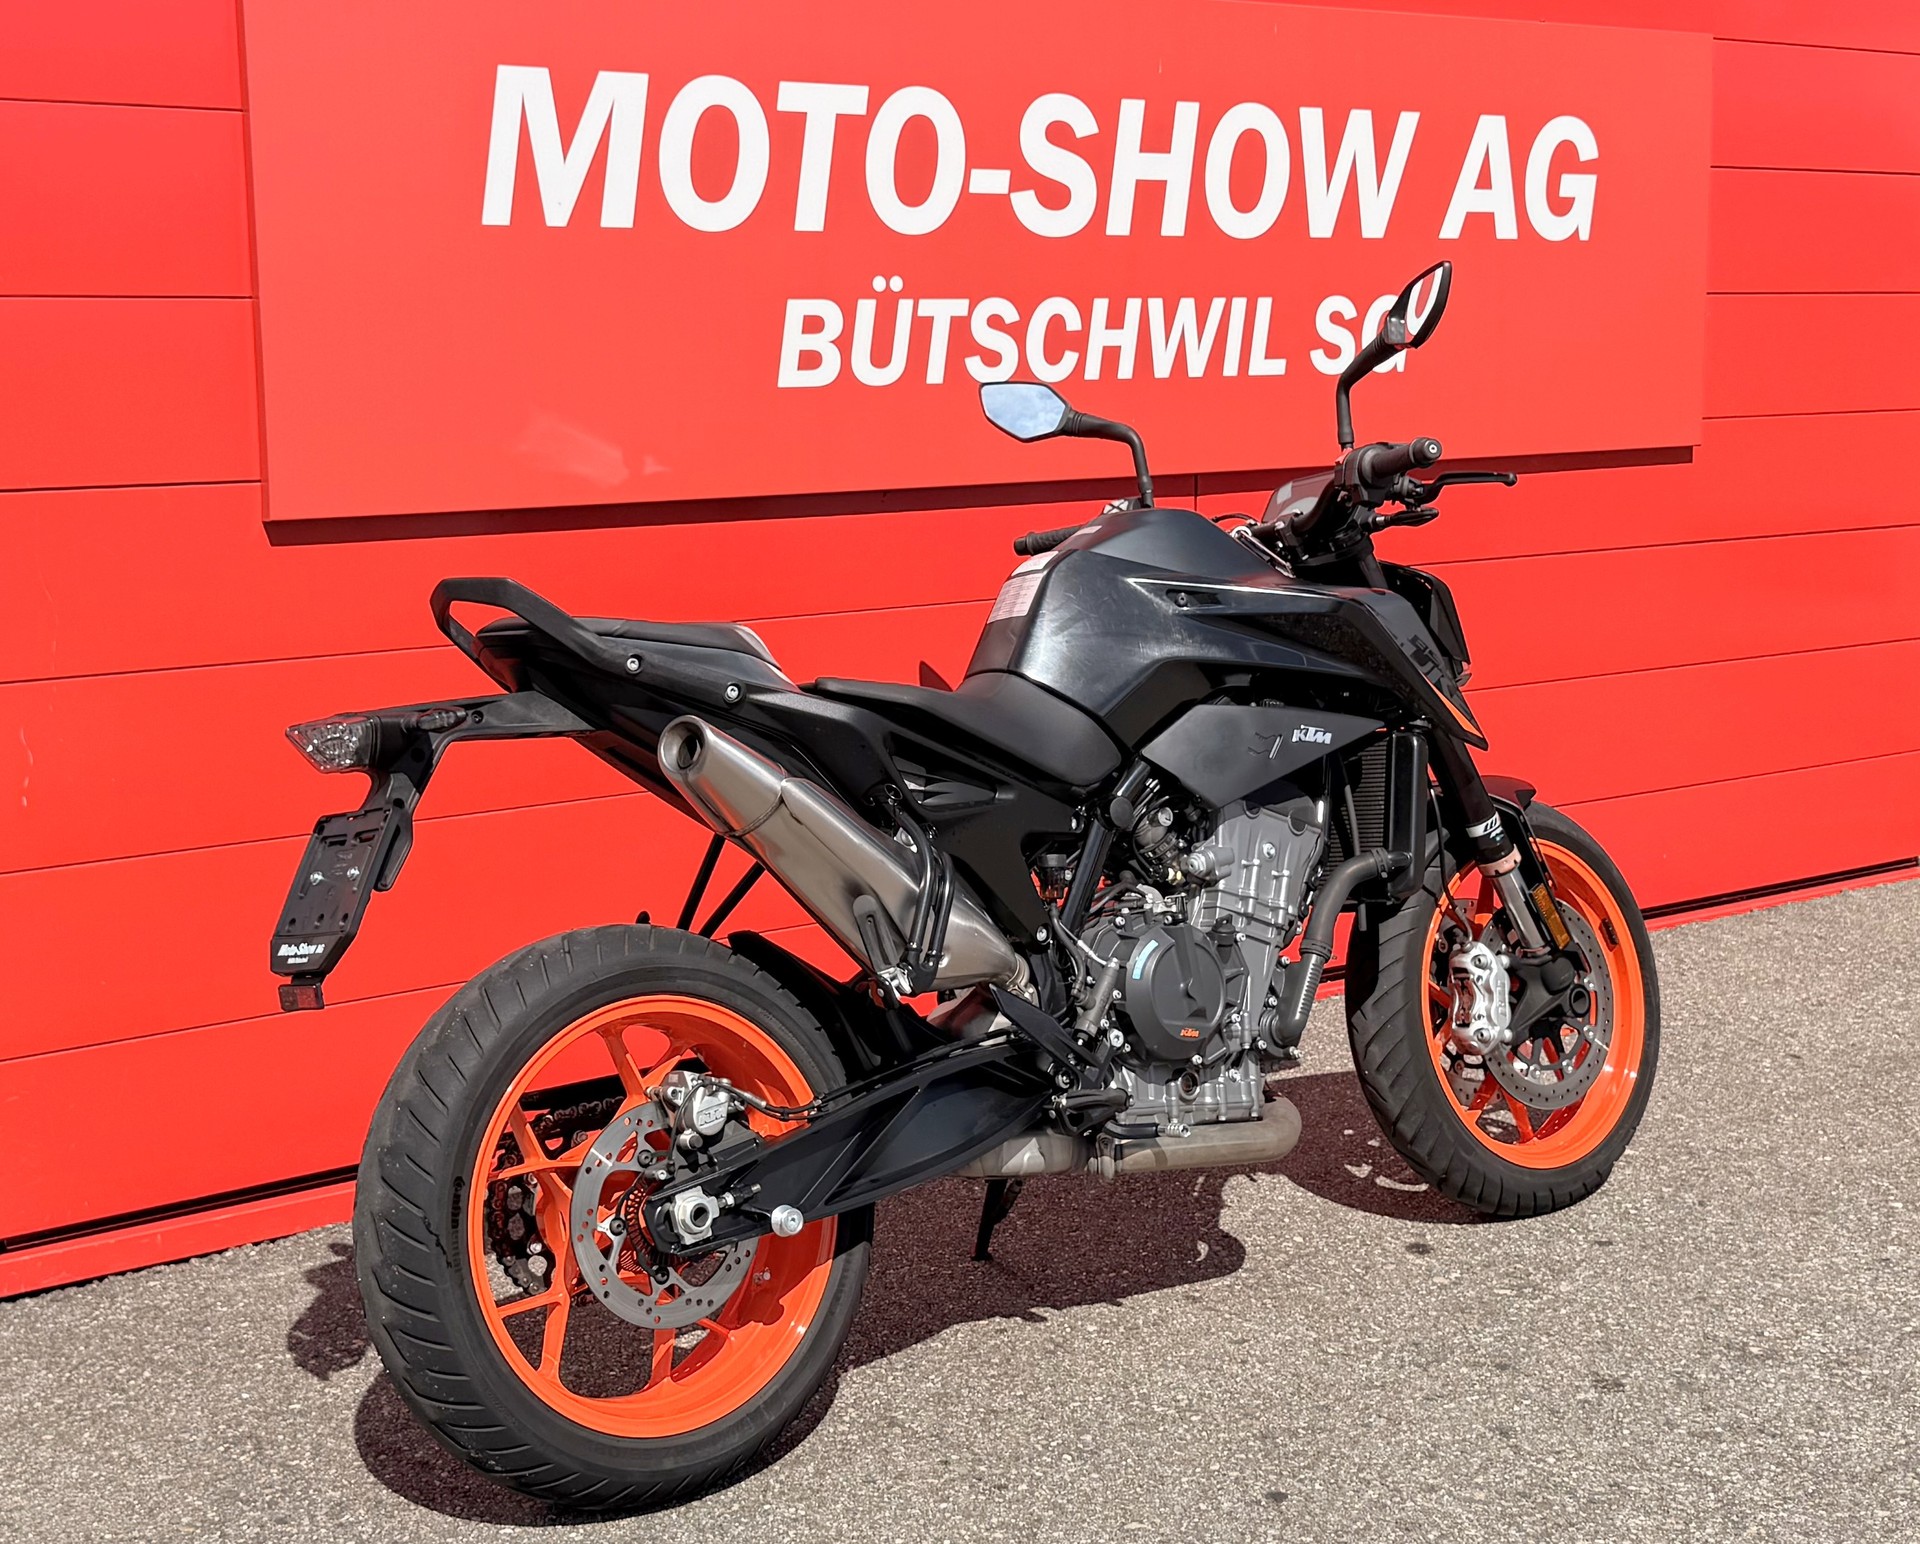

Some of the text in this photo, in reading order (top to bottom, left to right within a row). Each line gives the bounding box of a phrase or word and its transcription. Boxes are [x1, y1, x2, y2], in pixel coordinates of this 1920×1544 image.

[482, 65, 1599, 241] MOTO-SHOW AG
[778, 276, 1287, 388] BÜTSCHWIL
[1291, 724, 1333, 745] KTM
